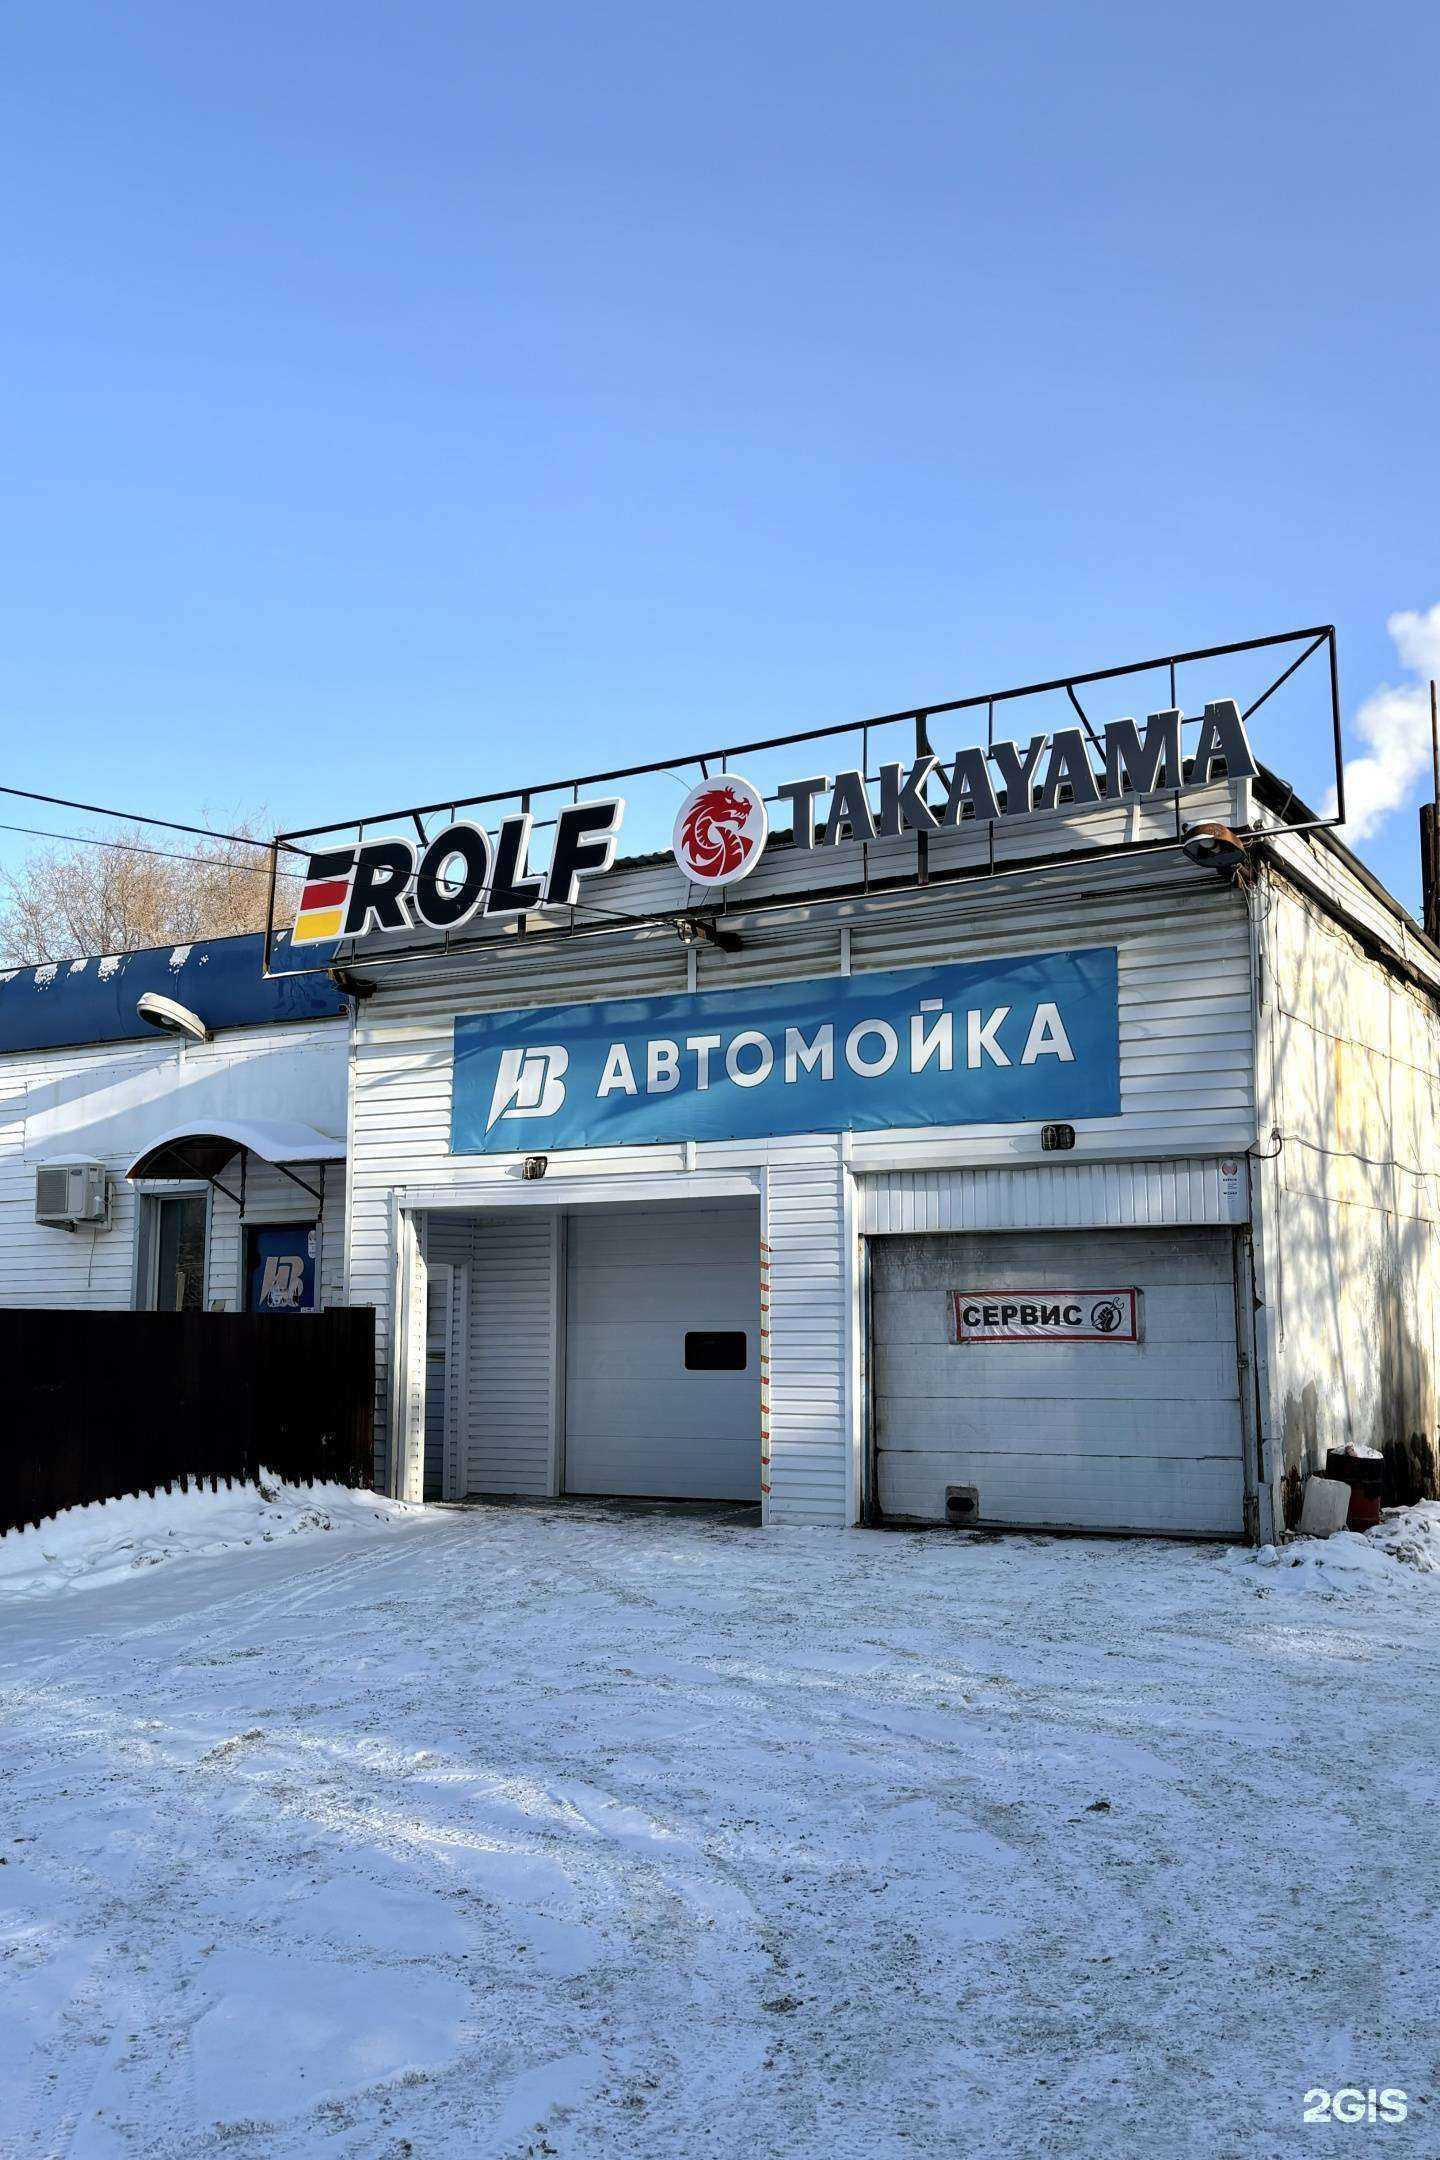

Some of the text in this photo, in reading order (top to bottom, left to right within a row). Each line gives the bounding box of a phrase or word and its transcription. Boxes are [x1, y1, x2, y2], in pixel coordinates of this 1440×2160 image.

[778, 698, 1260, 850] TAKAYAMA
[344, 797, 626, 937] ROLF
[596, 998, 1077, 1098] АВТОМОЙКА
[963, 1304, 1083, 1328] СЕРВИС
